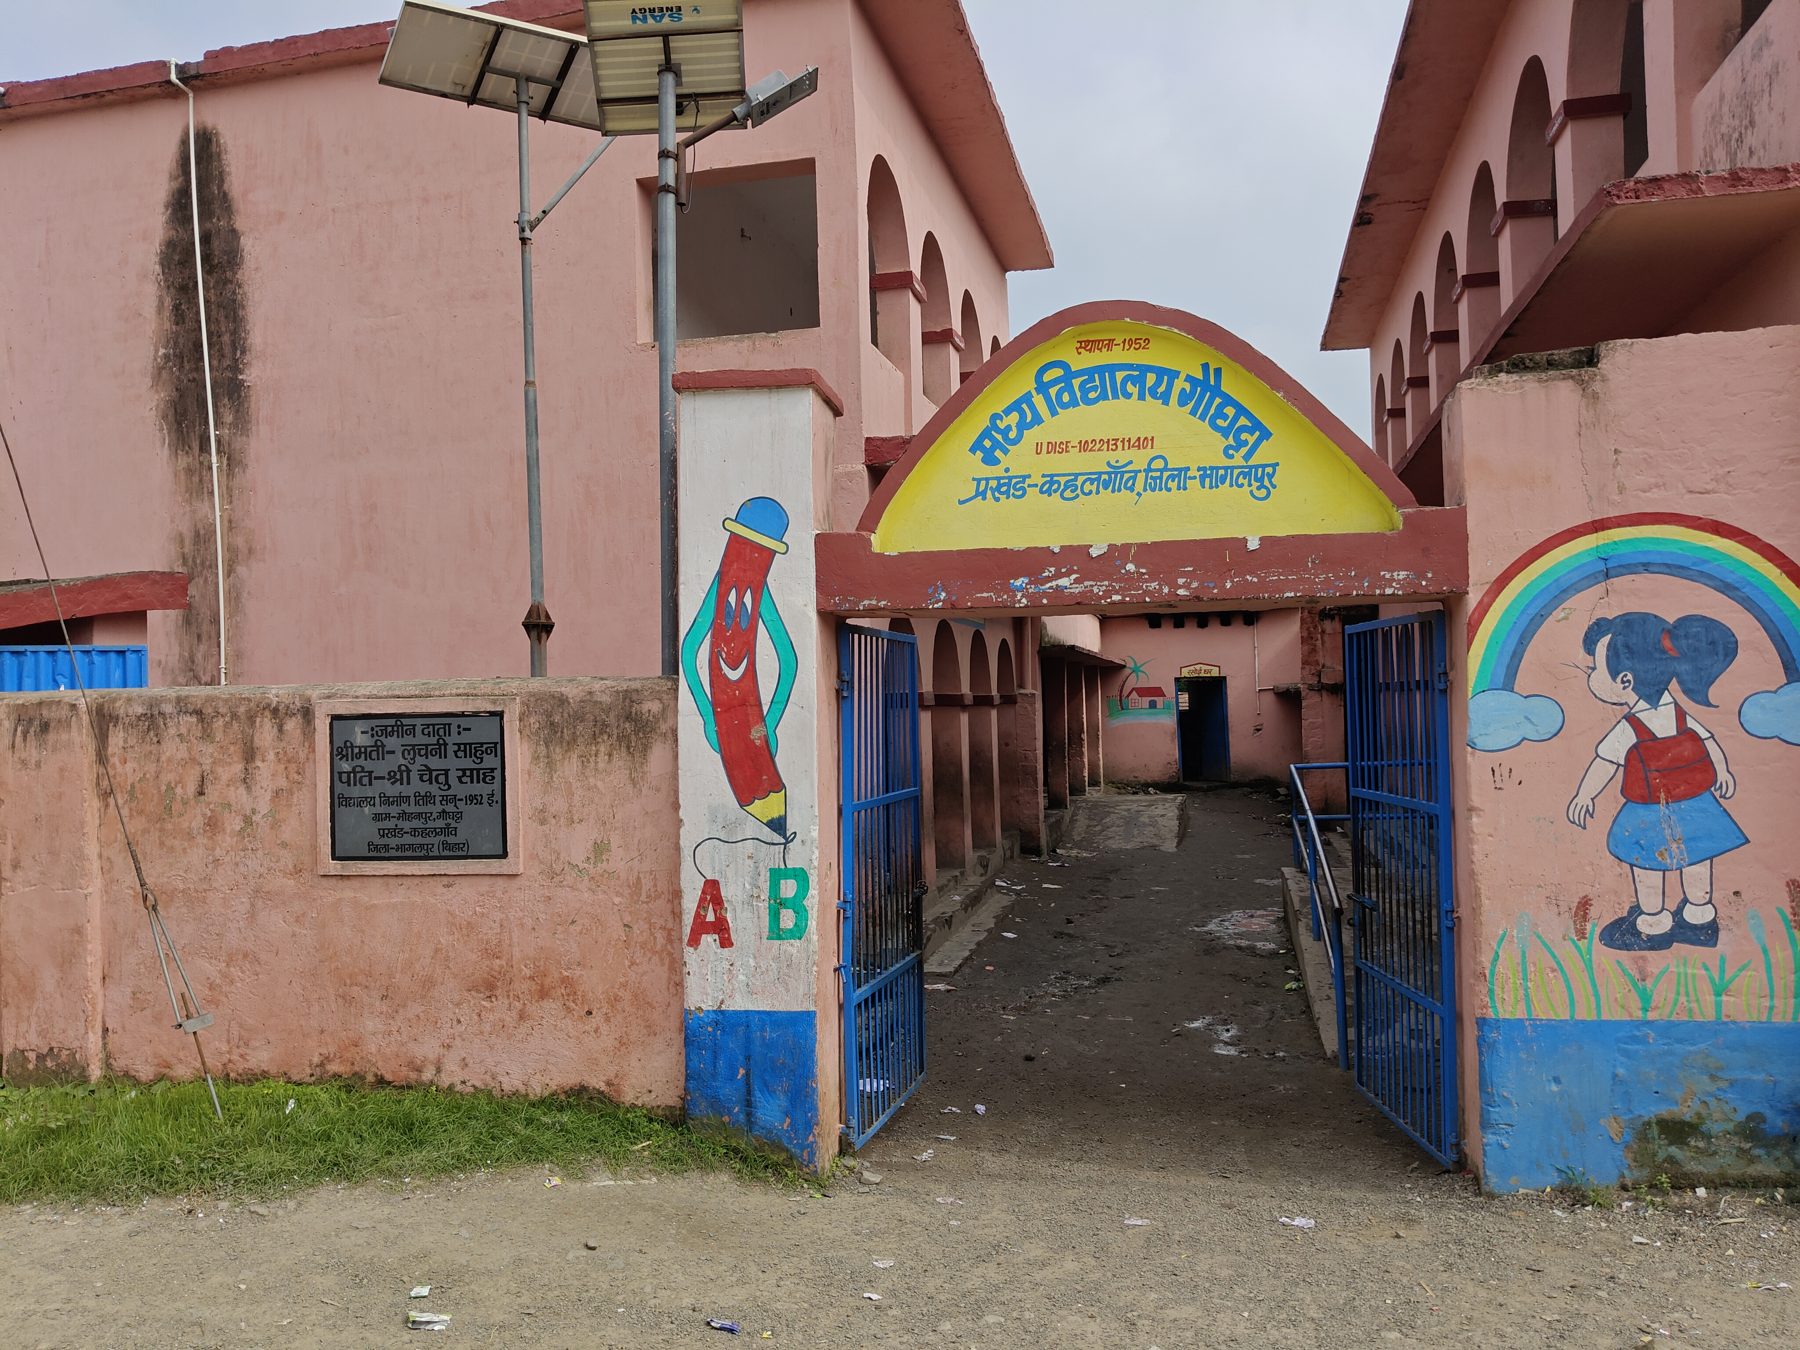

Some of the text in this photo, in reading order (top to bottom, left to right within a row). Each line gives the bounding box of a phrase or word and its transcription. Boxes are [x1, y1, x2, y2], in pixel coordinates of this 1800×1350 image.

[630, 5, 682, 15] ENERGY
[631, 12, 683, 25] SAN
[968, 390, 1045, 467] मध्य
[1034, 359, 1182, 419] विद्यालय
[421, 723, 452, 738] दाता
[401, 738, 449, 765] लुचनी
[453, 741, 499, 765] साहुन
[417, 764, 451, 791] चेतु
[456, 766, 498, 785] साह
[337, 791, 376, 809] विद्यालय
[379, 791, 411, 808] निर्माण
[414, 791, 436, 807] तिथि
[686, 866, 811, 949] A B
